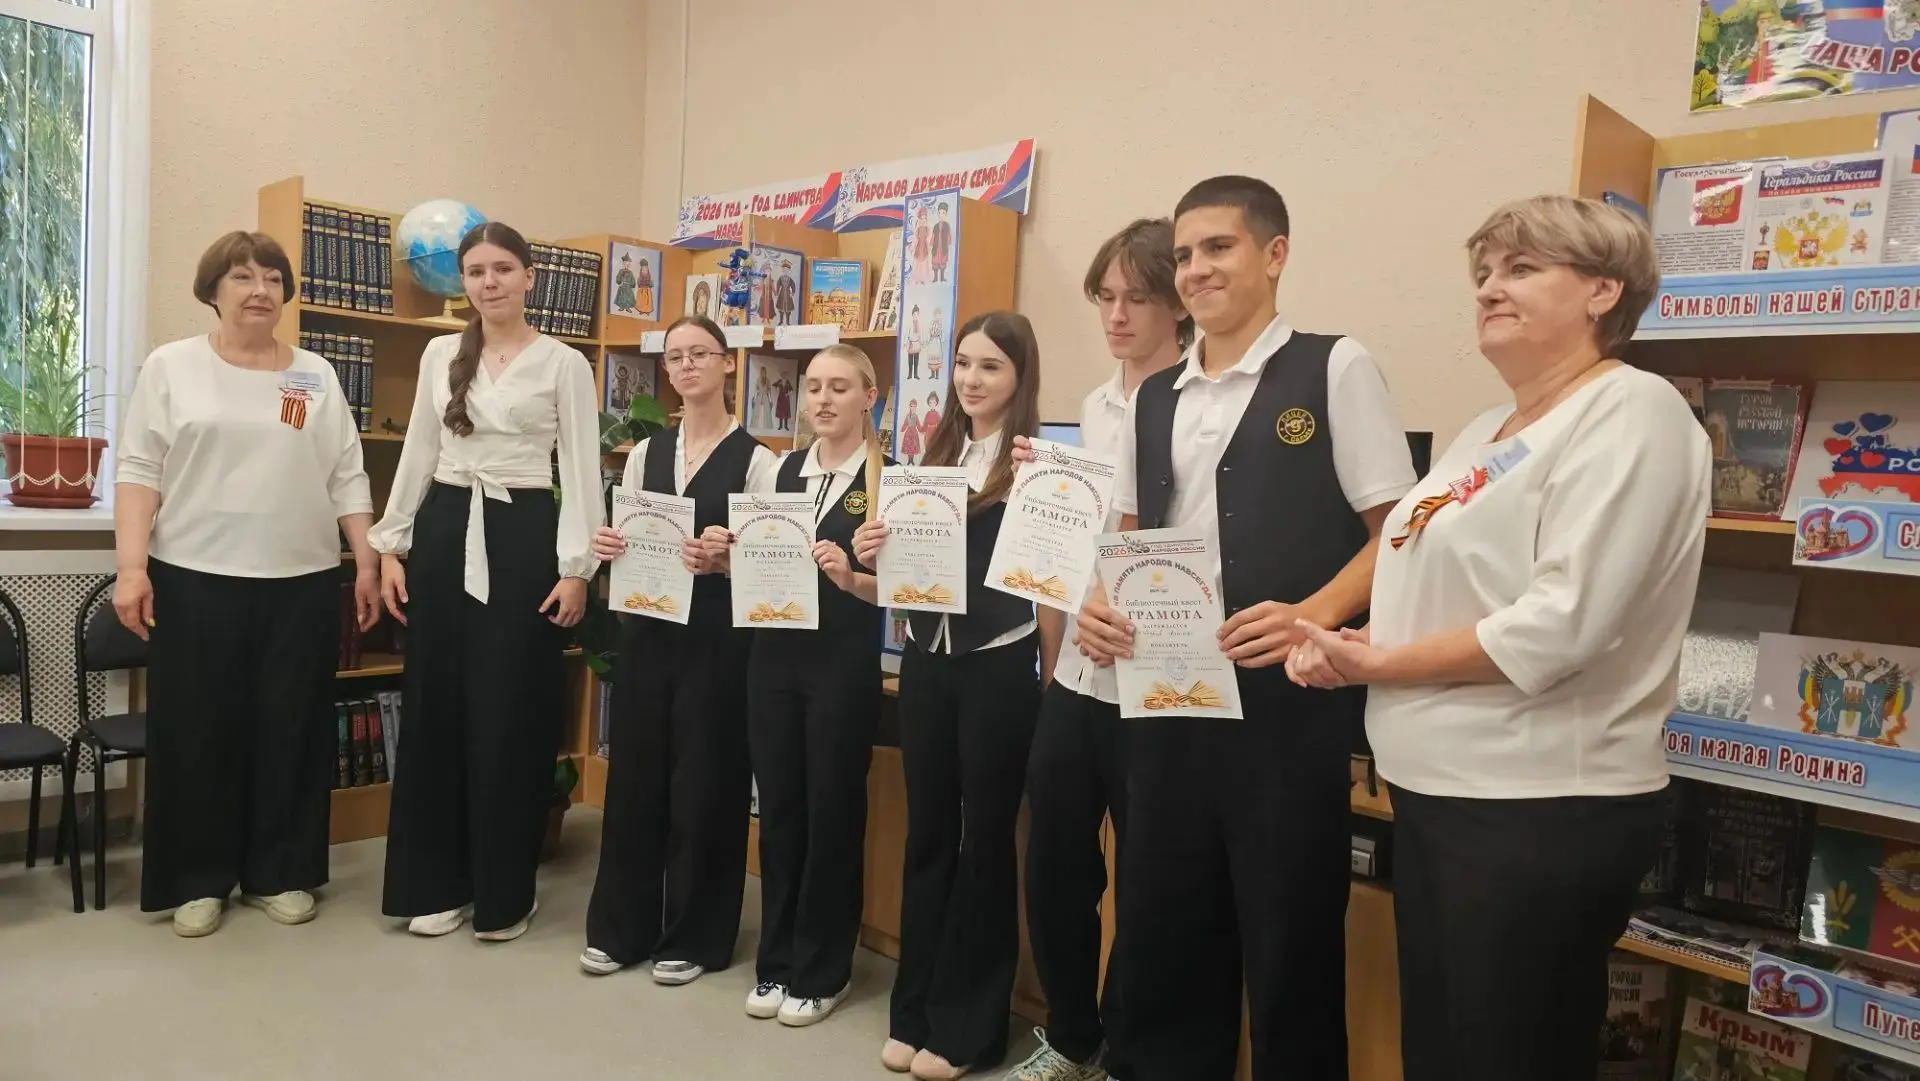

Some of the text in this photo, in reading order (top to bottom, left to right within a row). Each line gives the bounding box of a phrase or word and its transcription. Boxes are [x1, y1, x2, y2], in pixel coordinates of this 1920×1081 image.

[856, 164, 1008, 203] НАРОДОВ ДРУЖНАЯ СЕМЬЯ
[1764, 167, 1877, 191] Геральдика России
[695, 201, 722, 221] 2026
[773, 187, 823, 211] ЕДИНСТВА
[1659, 291, 1760, 320] Символы
[1769, 285, 1844, 315] нашей
[1050, 467, 1084, 483] НАРОДОВ
[906, 488, 937, 497] НАРОДОВ
[756, 514, 786, 523] НАРОДОВ
[1022, 504, 1089, 530] ГРАМОТА
[889, 527, 952, 537] ГРАМОТА
[1898, 520, 1920, 549] С
[744, 550, 804, 559] ГРАМОТА
[1100, 547, 1127, 557] 2026
[1114, 565, 1136, 593] ПАМЯТИ
[1135, 557, 1173, 571] НАРОДОВ
[1128, 609, 1204, 621] ГРАМОТА
[1700, 739, 1769, 768] малая
[1778, 748, 1865, 786] Родина
[1698, 1005, 1797, 1058] Крым
[1865, 1002, 1920, 1041] Путе
